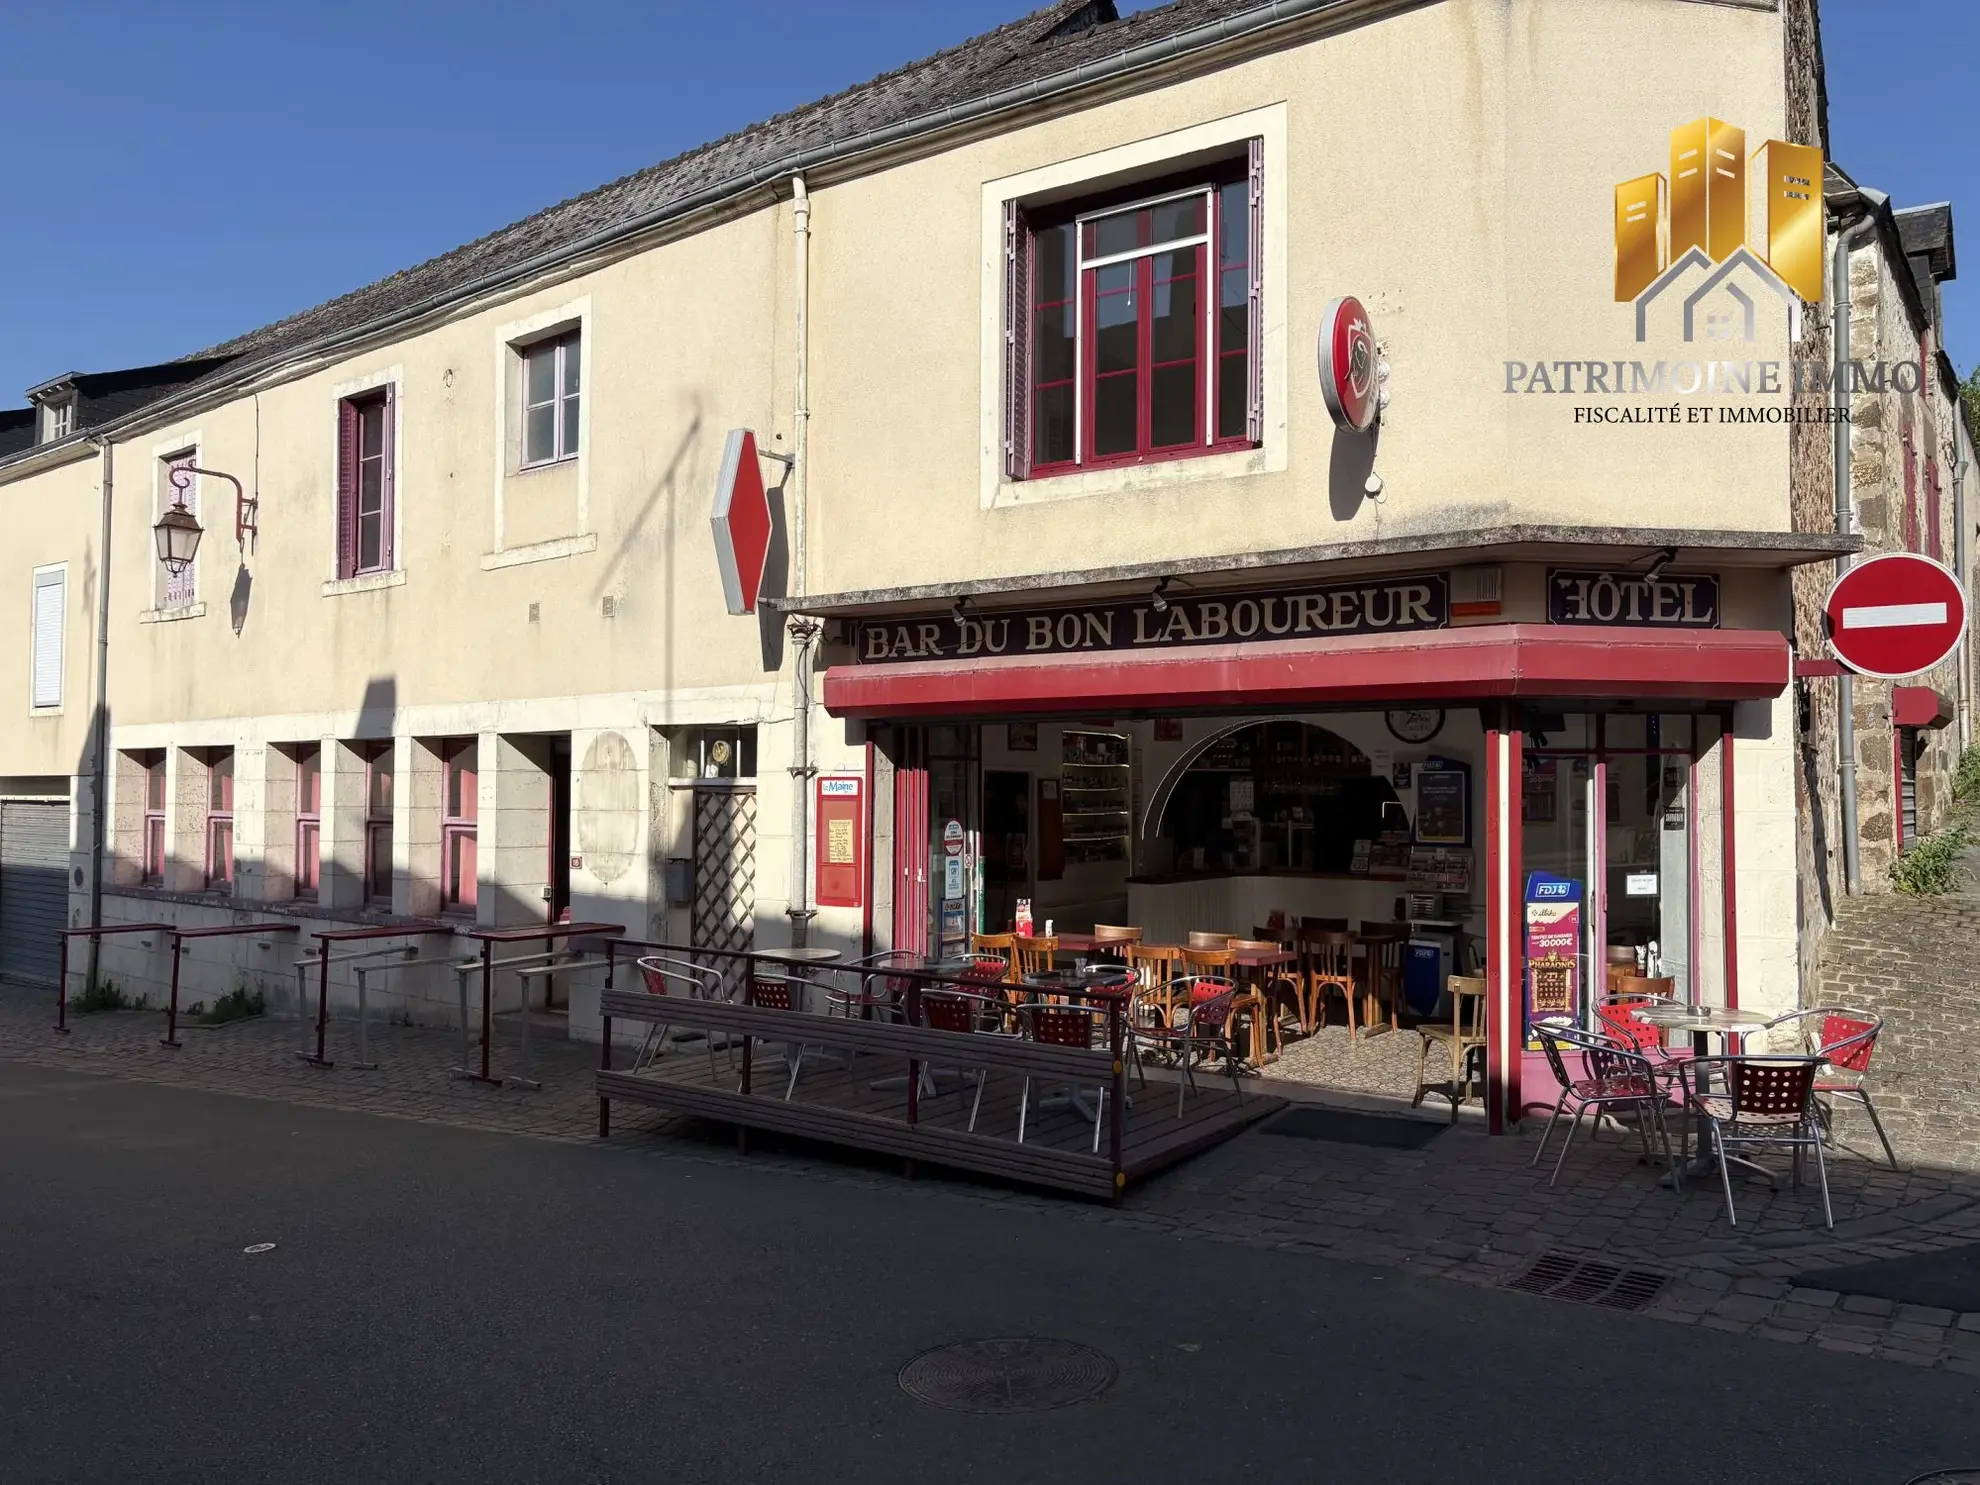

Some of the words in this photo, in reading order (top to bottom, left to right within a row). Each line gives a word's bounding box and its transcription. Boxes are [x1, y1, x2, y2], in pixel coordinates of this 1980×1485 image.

[1557, 572, 1713, 622] HÔTEL
[865, 623, 944, 660] BAR
[957, 618, 1010, 654] DU
[1025, 611, 1115, 650] BON
[1133, 584, 1438, 645] LABOUREUR
[829, 781, 853, 792] Maine
[1538, 885, 1557, 895] FDJ
